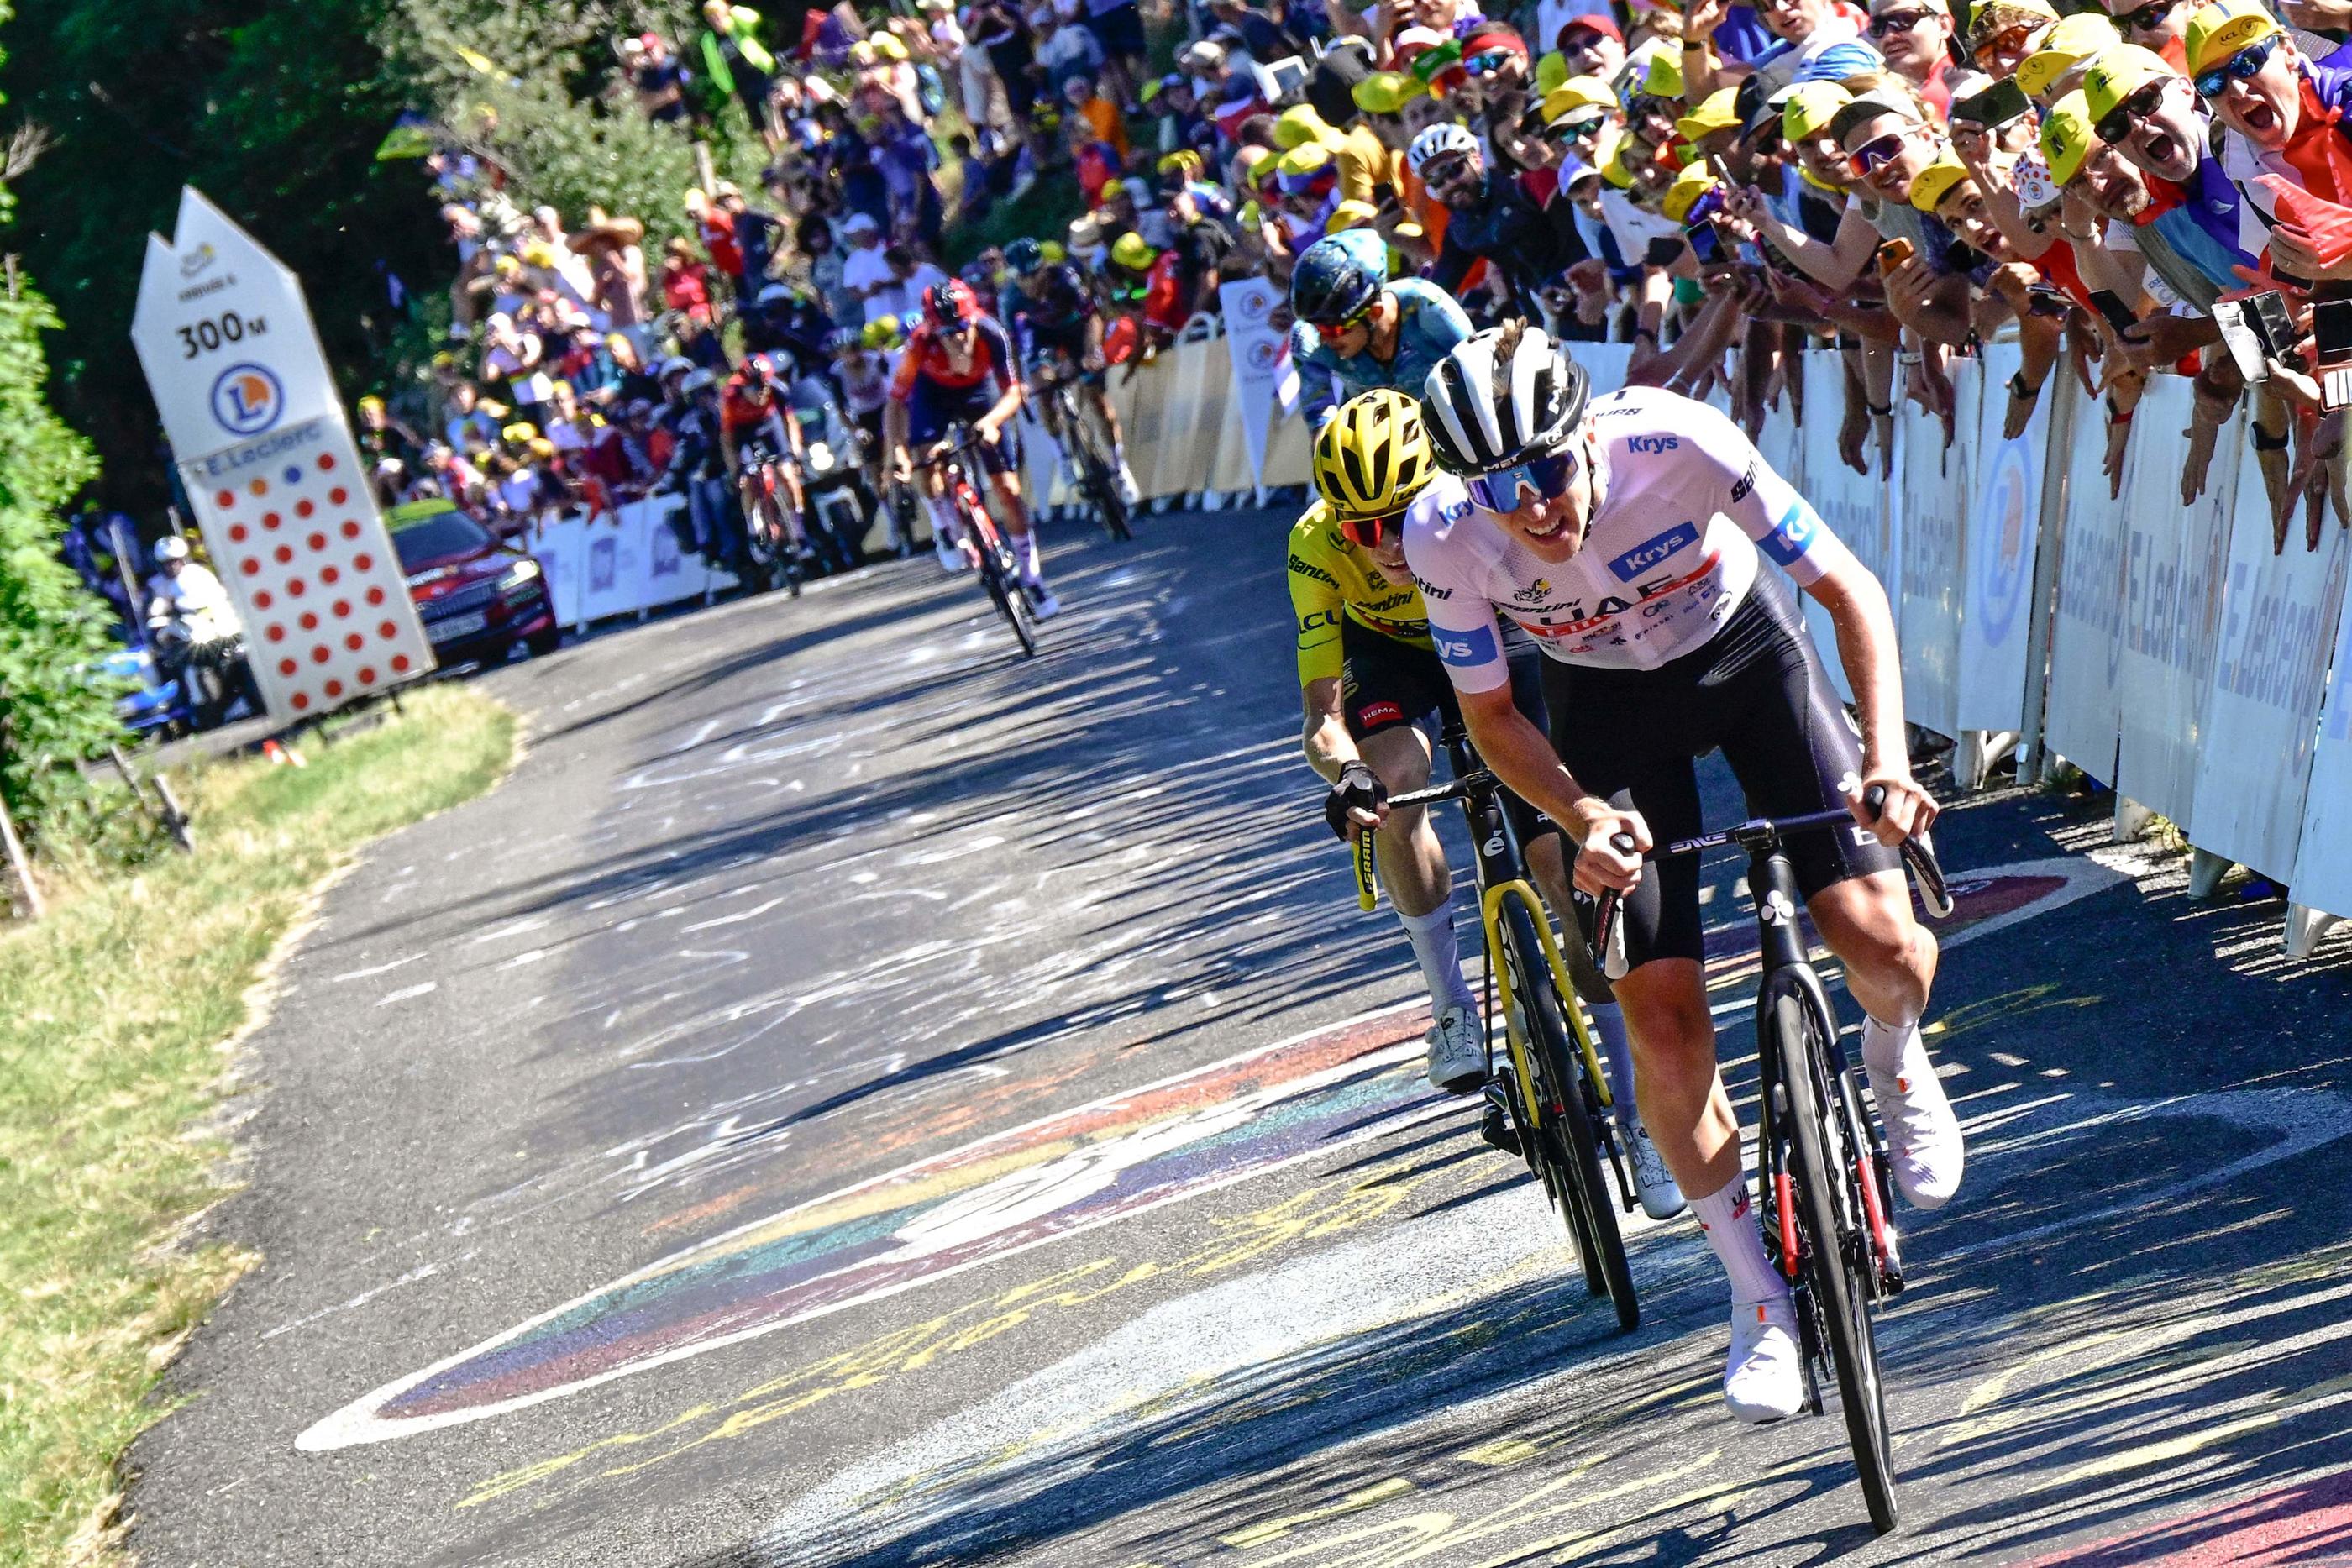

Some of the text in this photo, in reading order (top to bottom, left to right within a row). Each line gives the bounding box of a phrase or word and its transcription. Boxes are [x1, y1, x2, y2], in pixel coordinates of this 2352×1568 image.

[176, 312, 244, 359] 300
[1628, 436, 1678, 454] Krys
[1438, 498, 1475, 527] Kry
[1625, 535, 1684, 571] Krys
[2218, 562, 2316, 717] E.Leclerc
[1364, 706, 1397, 721] HEMA
[1362, 831, 1373, 884] SRAM
[1732, 1184, 1750, 1207] UA
